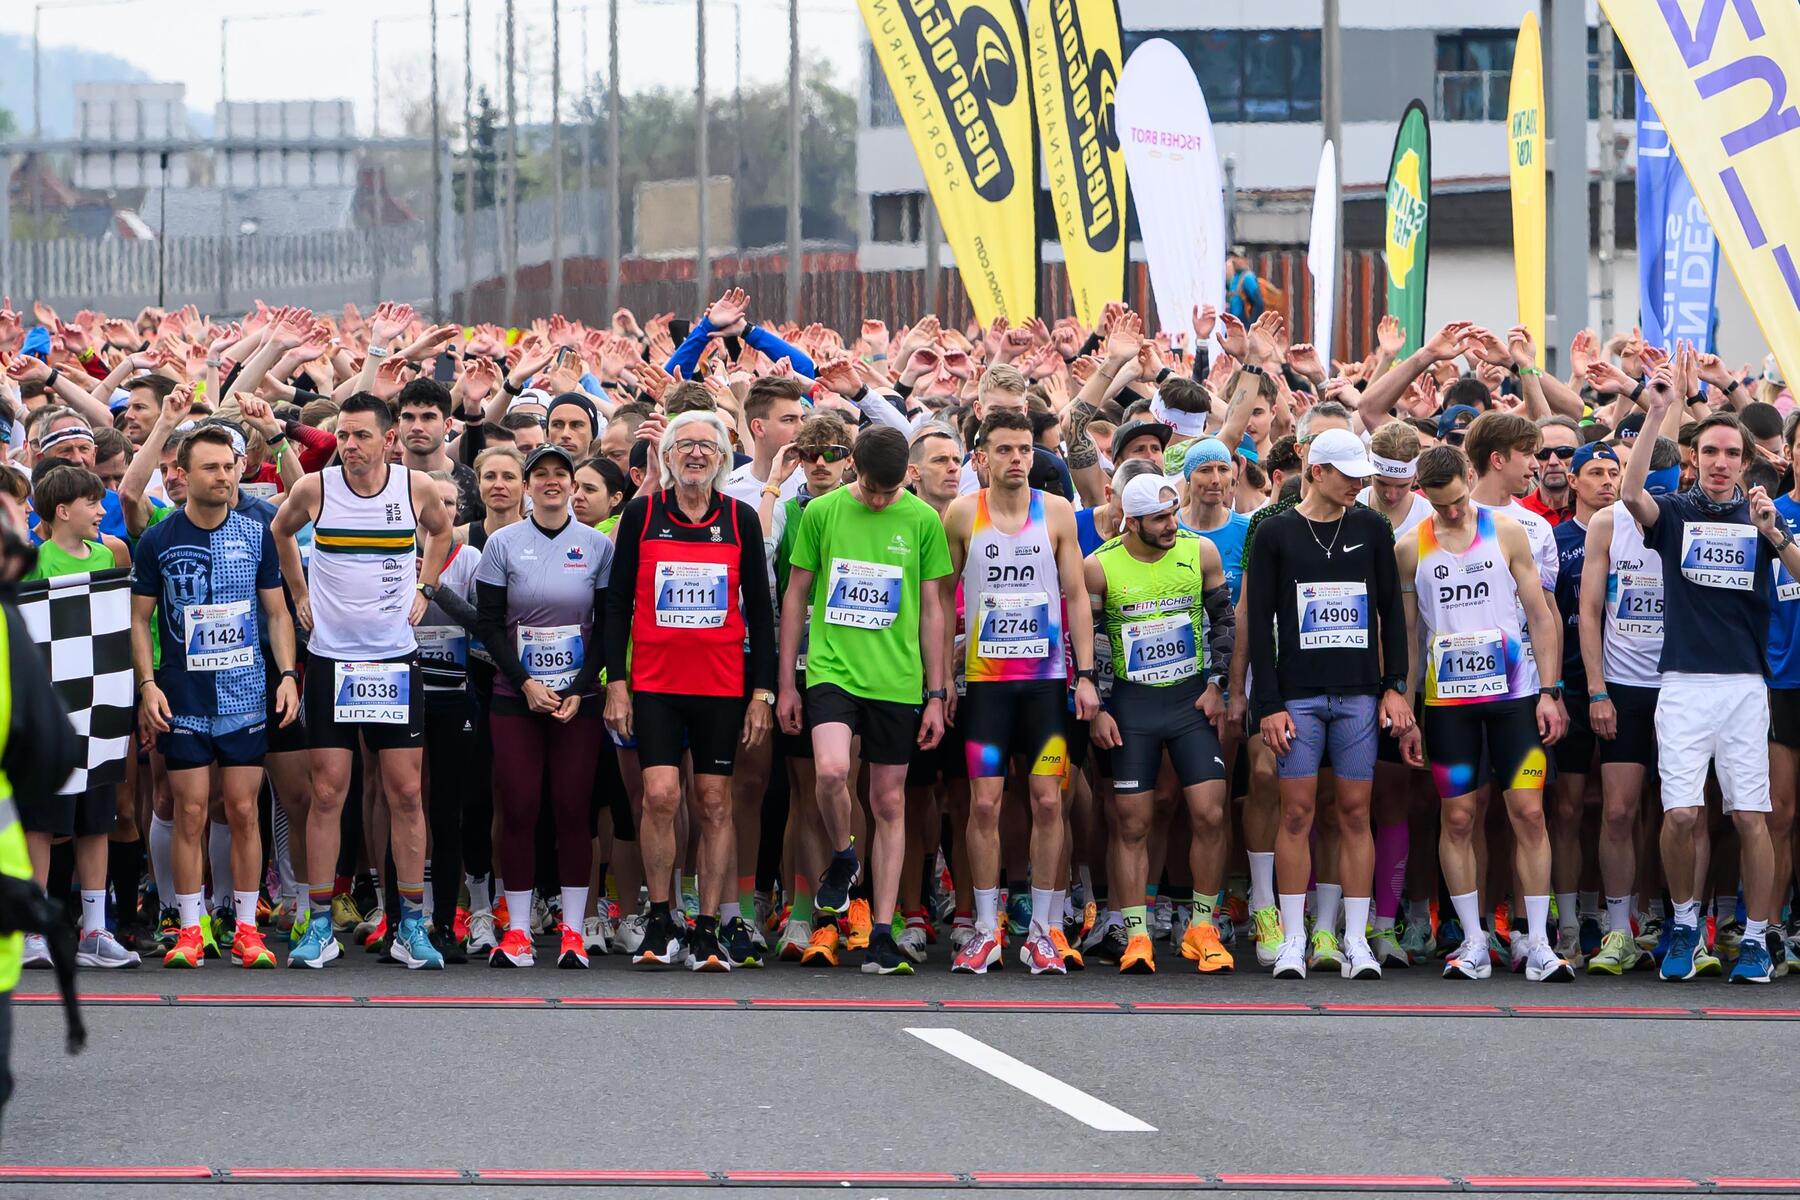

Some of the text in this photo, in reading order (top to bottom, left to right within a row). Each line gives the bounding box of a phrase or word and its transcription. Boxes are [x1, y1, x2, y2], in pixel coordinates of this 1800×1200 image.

[1385, 465, 1408, 474] JESUS
[385, 503, 394, 522] BIKE
[394, 503, 402, 521] RUN
[1694, 546, 1745, 564] 14356
[1685, 571, 1748, 586] LINZ AG
[666, 588, 715, 604] 11111
[840, 585, 889, 605] 14034
[660, 614, 721, 624] LINZ AG
[830, 611, 891, 627] LINZ AG
[1310, 608, 1359, 623] 14909
[989, 618, 1038, 634] 12746
[1618, 622, 1652, 634] LINZ
[197, 626, 246, 646] 11424
[1305, 635, 1364, 645] LINZ AG
[982, 645, 1044, 655] LINZ AG
[1136, 640, 1186, 661] 12896
[192, 653, 249, 667] LINZ AG
[527, 651, 574, 667] 13963
[1446, 655, 1496, 672] 11426
[1132, 664, 1193, 683] LINZ AG
[347, 683, 398, 698] 10338
[1442, 681, 1502, 694] LINZ AG
[339, 709, 404, 720] LINZ AG
